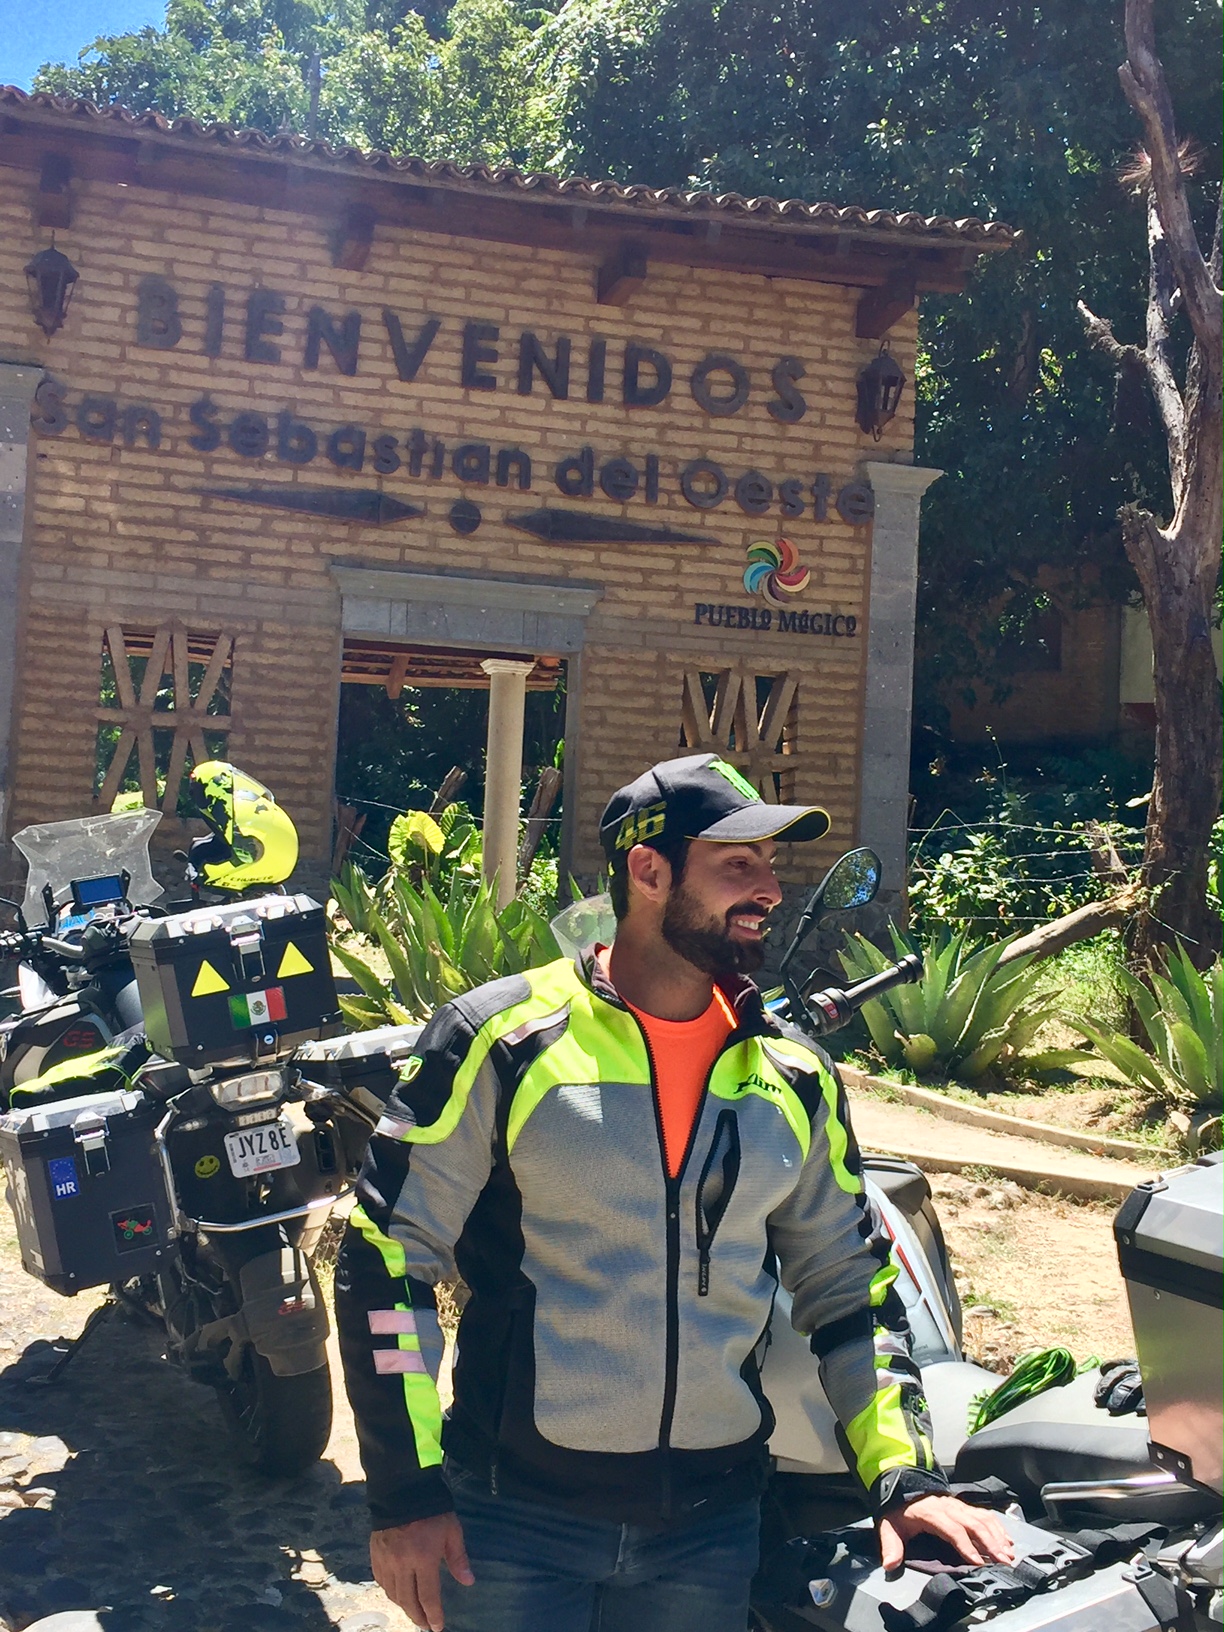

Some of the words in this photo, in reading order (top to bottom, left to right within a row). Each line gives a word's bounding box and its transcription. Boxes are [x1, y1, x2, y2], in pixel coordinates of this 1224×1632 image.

[136, 273, 808, 424] BIENVENIDOS
[30, 378, 162, 449] San
[554, 446, 659, 505] del
[679, 457, 875, 526] Oeste
[693, 602, 772, 631] PUEBLO
[614, 800, 668, 851] 46
[63, 1030, 96, 1049] GS
[55, 1181, 77, 1197] HR
